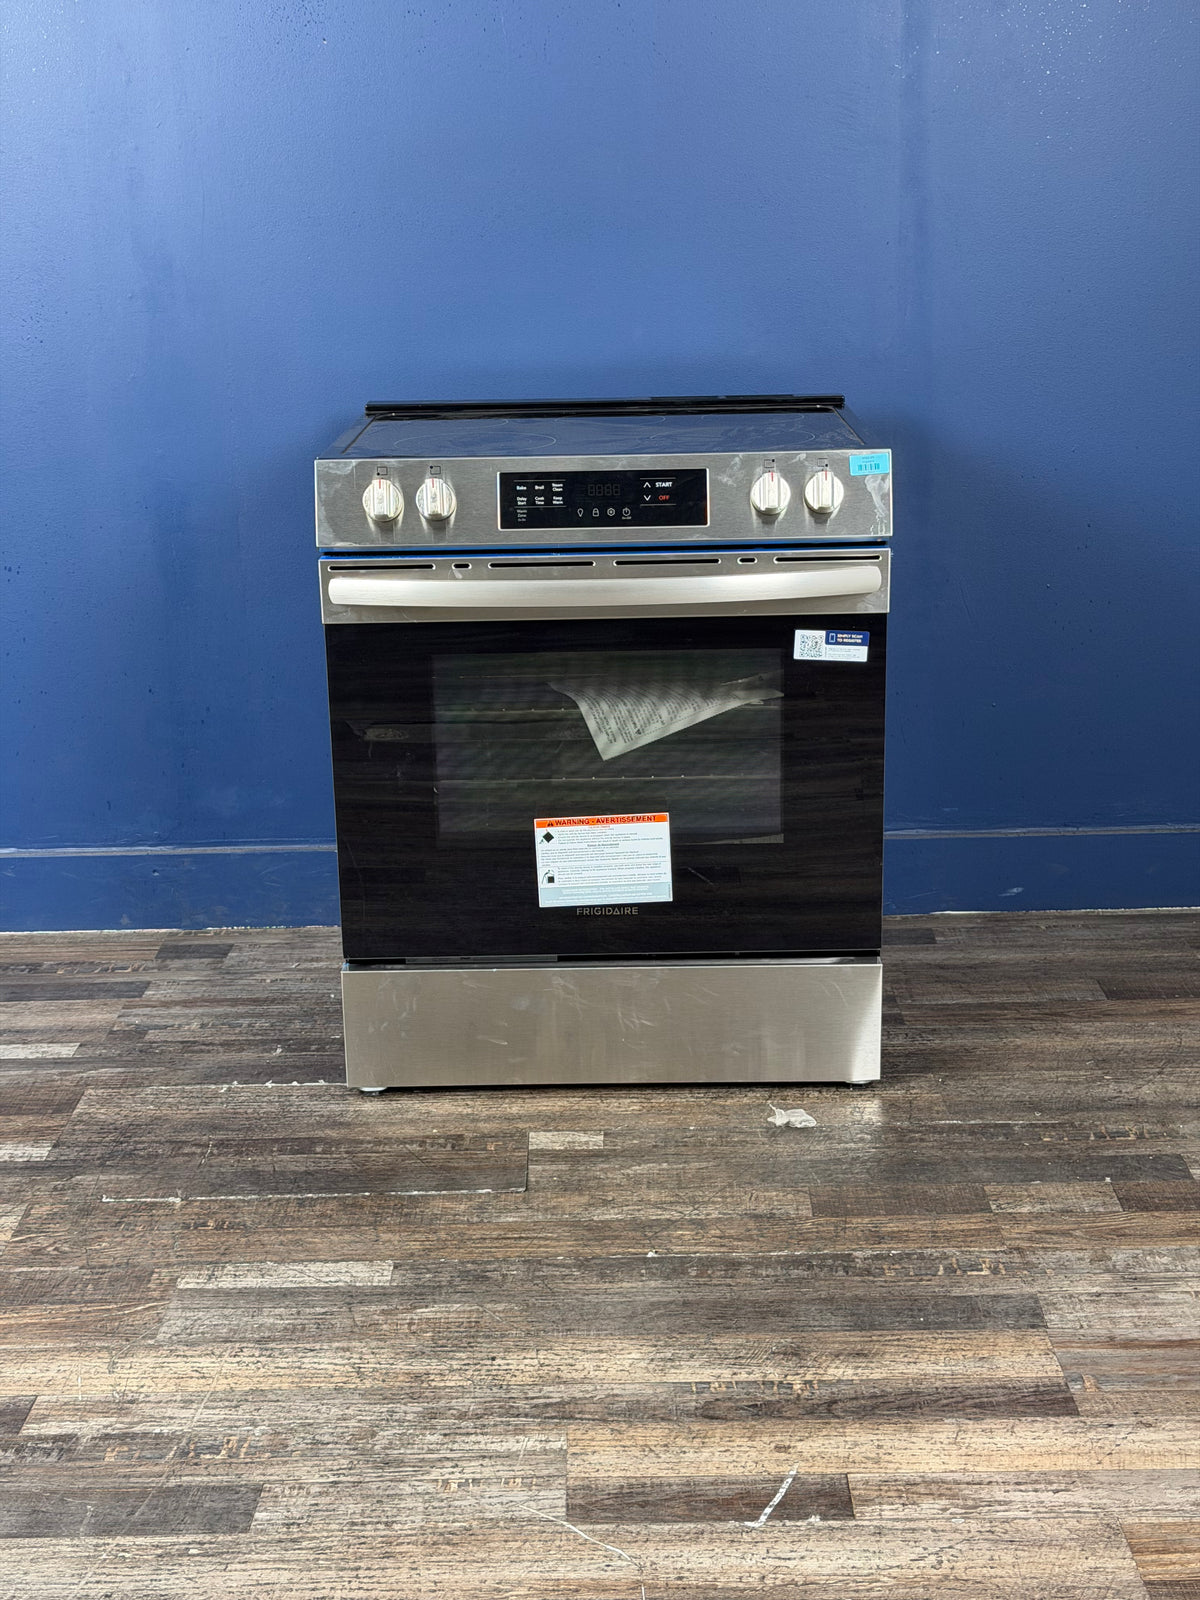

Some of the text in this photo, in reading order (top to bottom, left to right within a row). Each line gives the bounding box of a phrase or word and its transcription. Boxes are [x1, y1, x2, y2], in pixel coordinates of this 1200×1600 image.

[554, 818, 590, 826] WARNING
[596, 815, 656, 824] AVERTISSEMENT
[576, 906, 639, 916] FRIGIDAIRE
